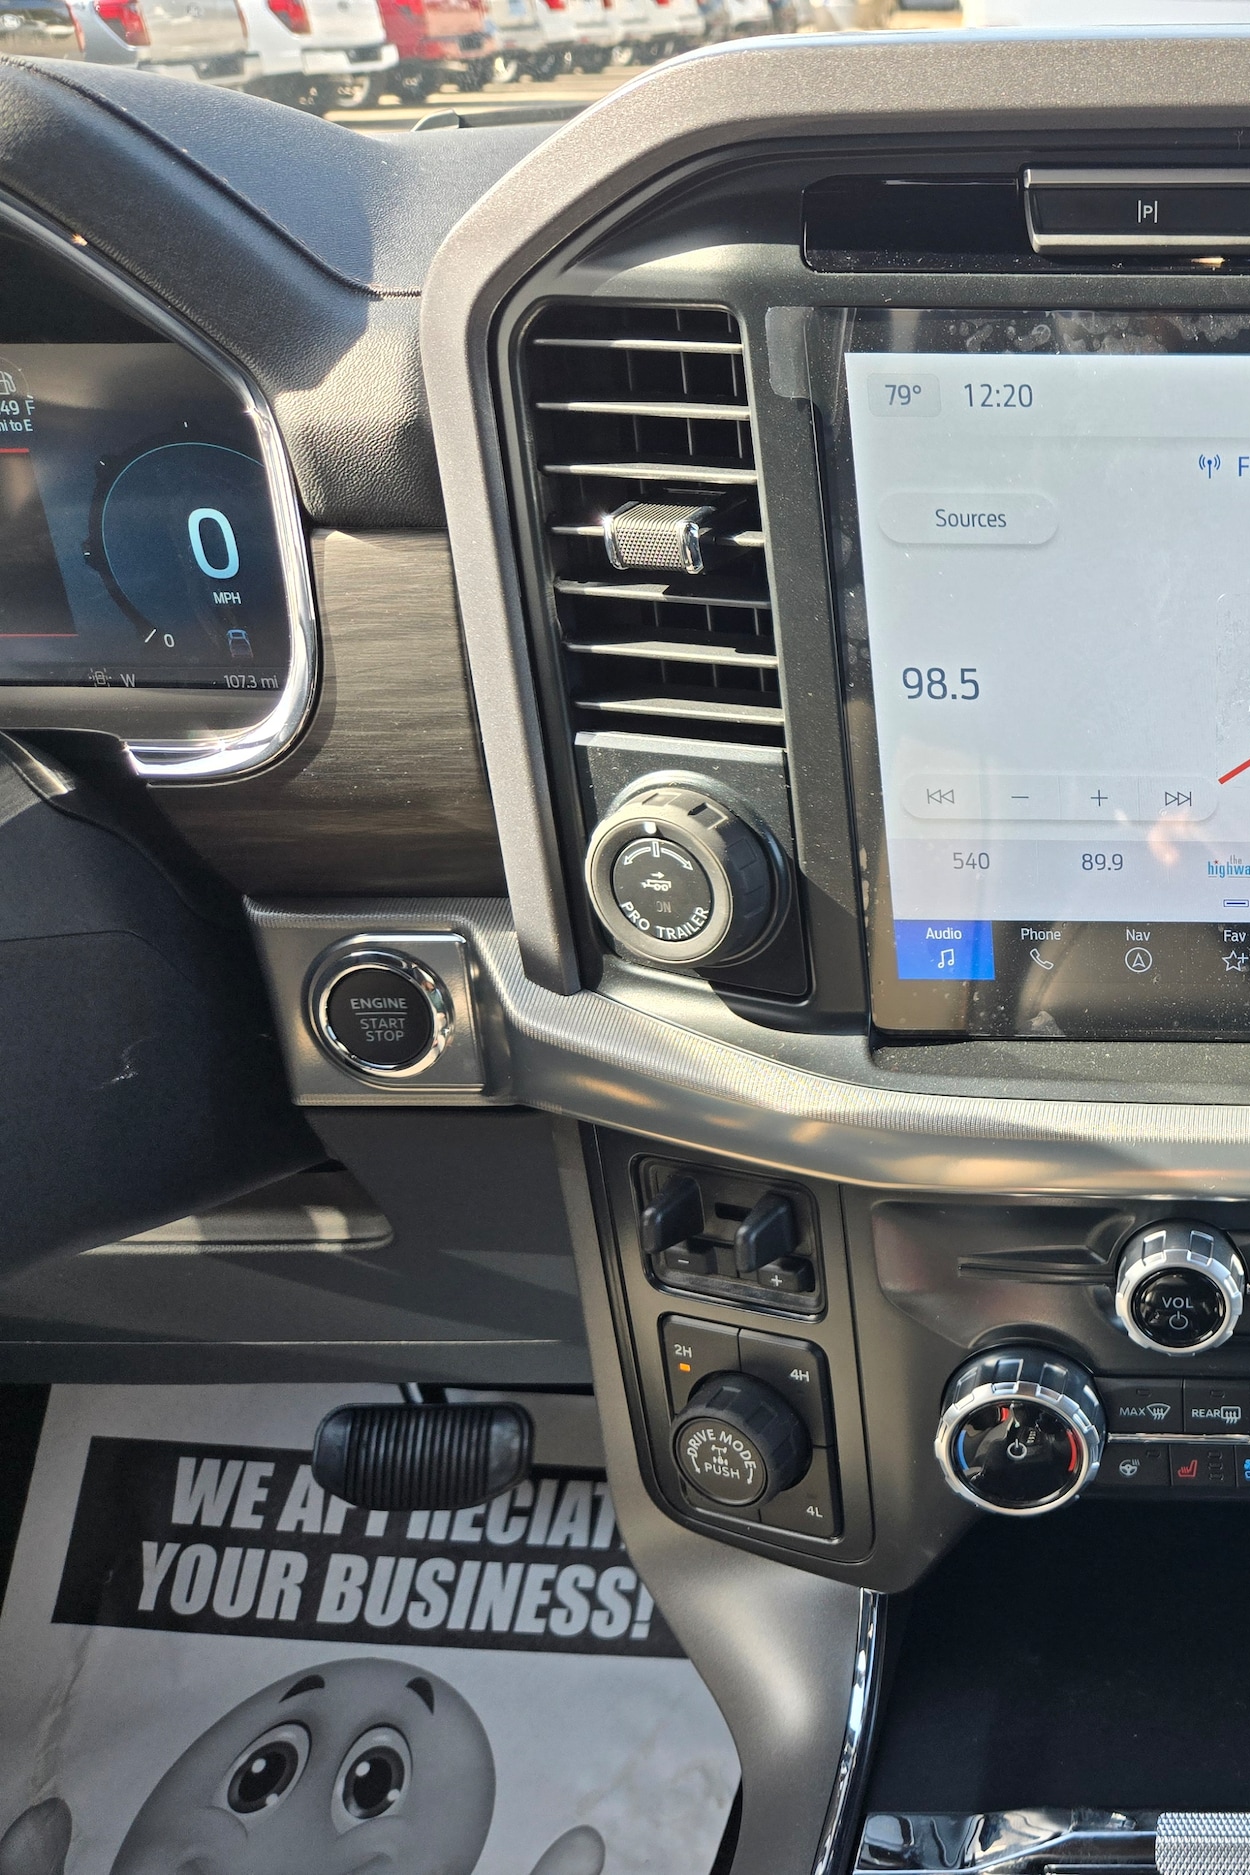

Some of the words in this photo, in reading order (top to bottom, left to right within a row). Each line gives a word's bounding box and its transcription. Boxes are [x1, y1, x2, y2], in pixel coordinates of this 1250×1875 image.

[884, 384, 922, 406] 79°
[964, 383, 1034, 409] 12:20
[25, 400, 35, 415] F
[9, 420, 22, 431] to
[23, 419, 33, 431] E
[935, 509, 1007, 529] Sources
[188, 508, 239, 579] 0
[213, 592, 241, 604] MPH
[164, 634, 175, 647] 0
[120, 674, 136, 687] W
[224, 674, 257, 688] 107.3
[261, 675, 279, 688] mi
[902, 667, 980, 701] 98.5
[952, 852, 990, 871] 540
[1081, 853, 1124, 872] 89.9
[1230, 855, 1242, 864] the
[621, 901, 651, 931] PRO
[656, 906, 709, 940] TRAILER
[925, 927, 962, 941] Audio
[1020, 928, 1061, 942] Phone
[1125, 929, 1151, 941] Nav
[1223, 929, 1246, 942] Fav
[350, 998, 408, 1009] ENGINE
[360, 1018, 405, 1029] START
[366, 1030, 404, 1041] STOP
[1162, 1297, 1193, 1309] VOL
[674, 1344, 692, 1358] 2H
[790, 1369, 810, 1383] 4H
[1120, 1407, 1145, 1416] MAX
[1192, 1409, 1220, 1418] REAR
[687, 1428, 716, 1458] DRIVE
[719, 1431, 756, 1469] MODE
[704, 1461, 740, 1480] PUSH
[171, 1456, 275, 1532] WE
[806, 1506, 823, 1518] 4L
[137, 1539, 308, 1622] YOUR
[316, 1553, 654, 1641] BUSINESS!
